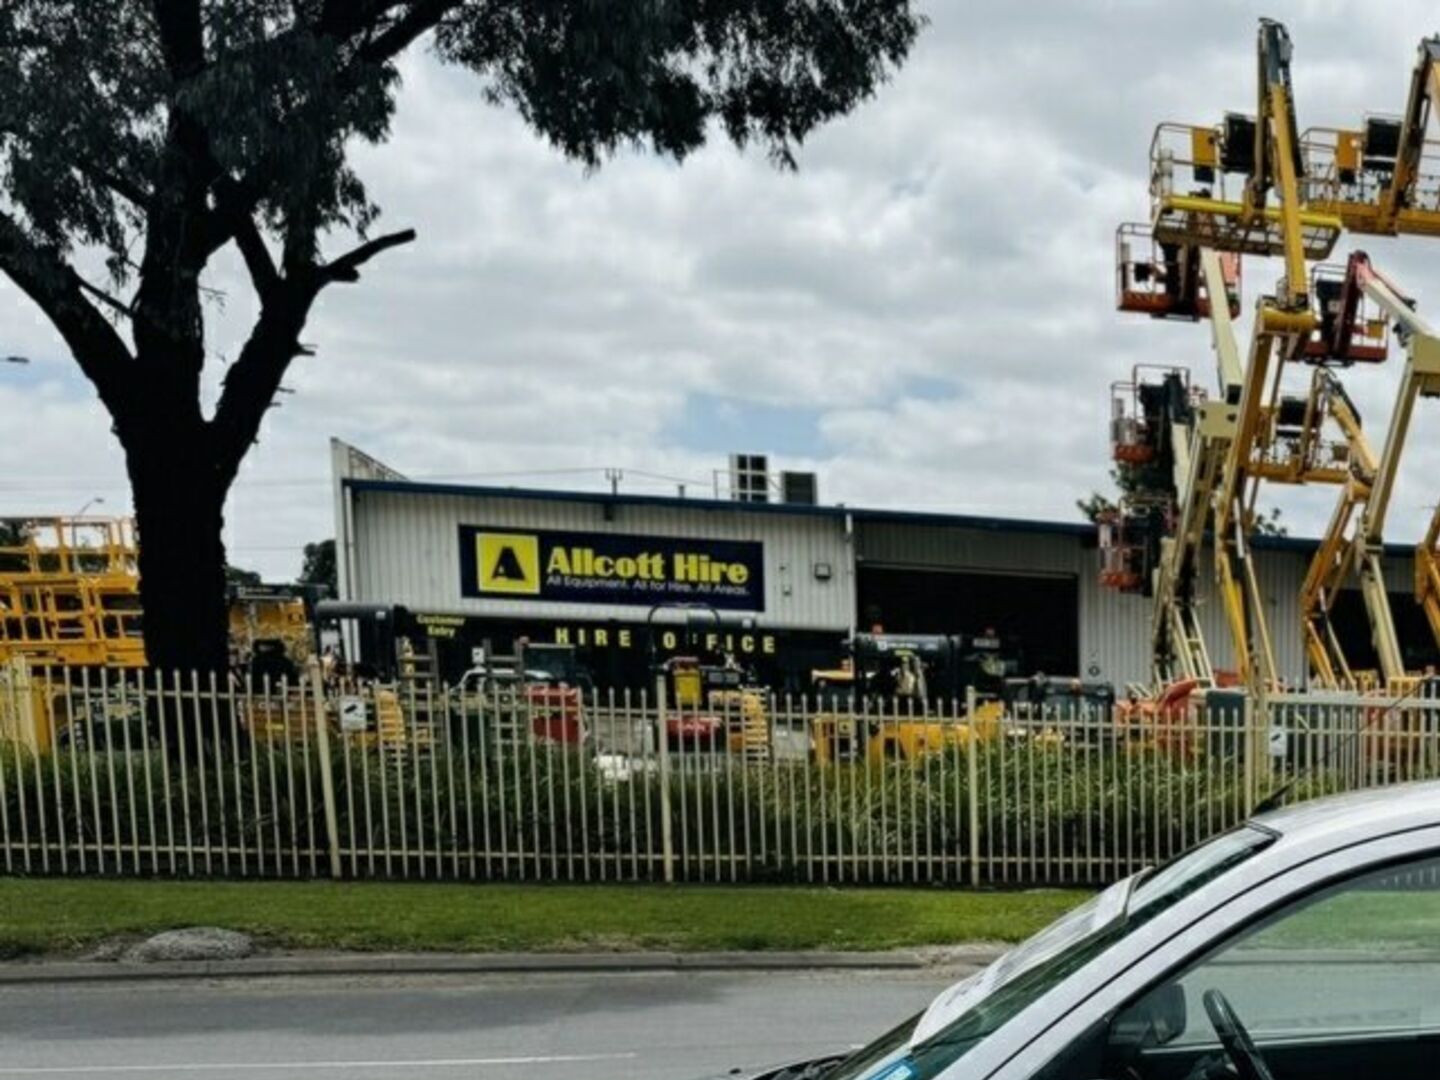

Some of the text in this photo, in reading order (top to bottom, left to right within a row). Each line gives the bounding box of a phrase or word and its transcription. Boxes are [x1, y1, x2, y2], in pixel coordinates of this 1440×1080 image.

[491, 546, 526, 580] A
[546, 546, 749, 584] Allcott Hire
[555, 628, 631, 647] HIRE
